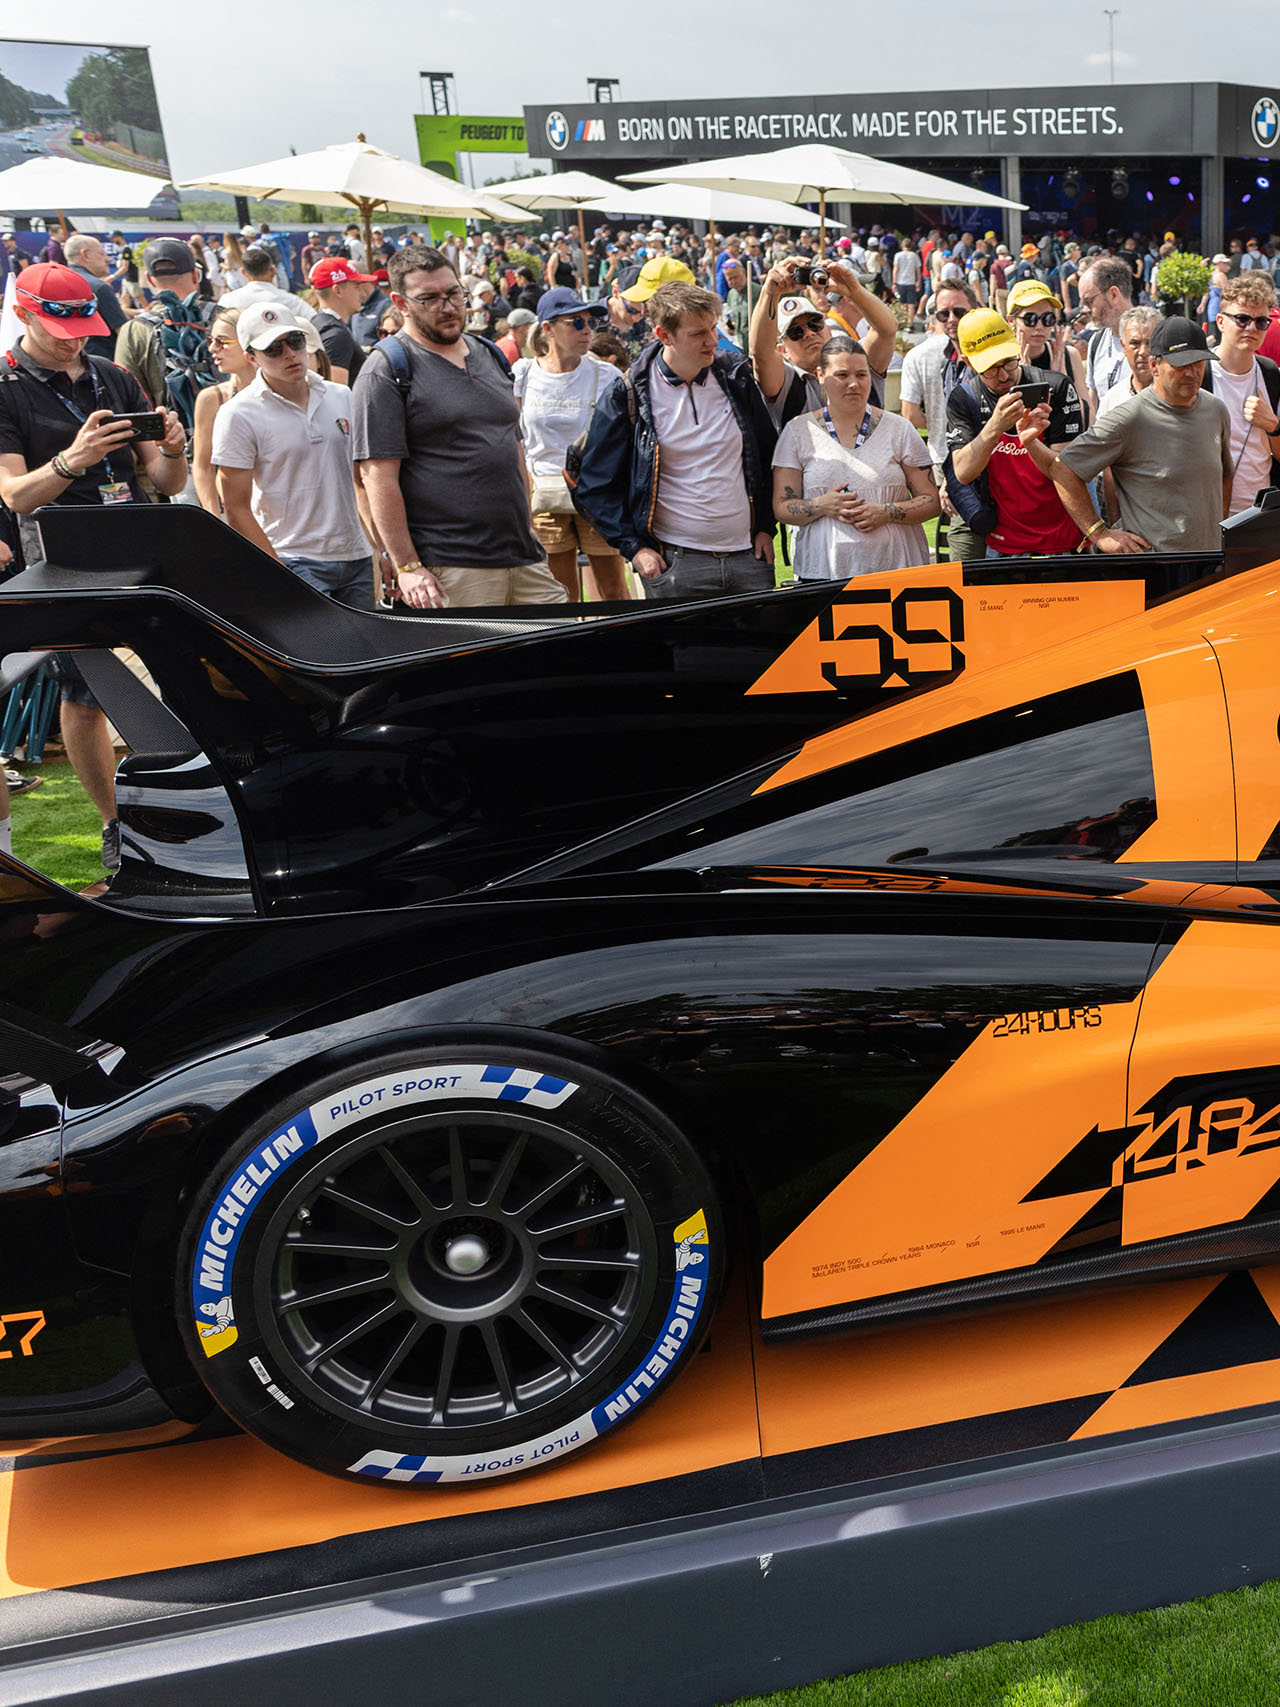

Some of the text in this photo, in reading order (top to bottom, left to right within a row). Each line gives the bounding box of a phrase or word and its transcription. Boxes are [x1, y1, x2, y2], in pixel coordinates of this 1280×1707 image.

[460, 124, 507, 141] PEUGEOT
[617, 106, 1124, 142] BORN ON THE RACETRACK. MADE FOR THE STREETS.
[976, 329, 1006, 345] DUNLOP
[817, 586, 966, 690] 59
[330, 1076, 462, 1120] PILOT SPORT
[200, 1126, 304, 1292] MICHELIN
[925, 1240, 956, 1250] MONACO
[811, 1252, 922, 1279] McLAREN TRIPLE CROWN YEARS
[603, 1276, 703, 1422] MICHELIN
[461, 1431, 580, 1475] PILOT SPORT
